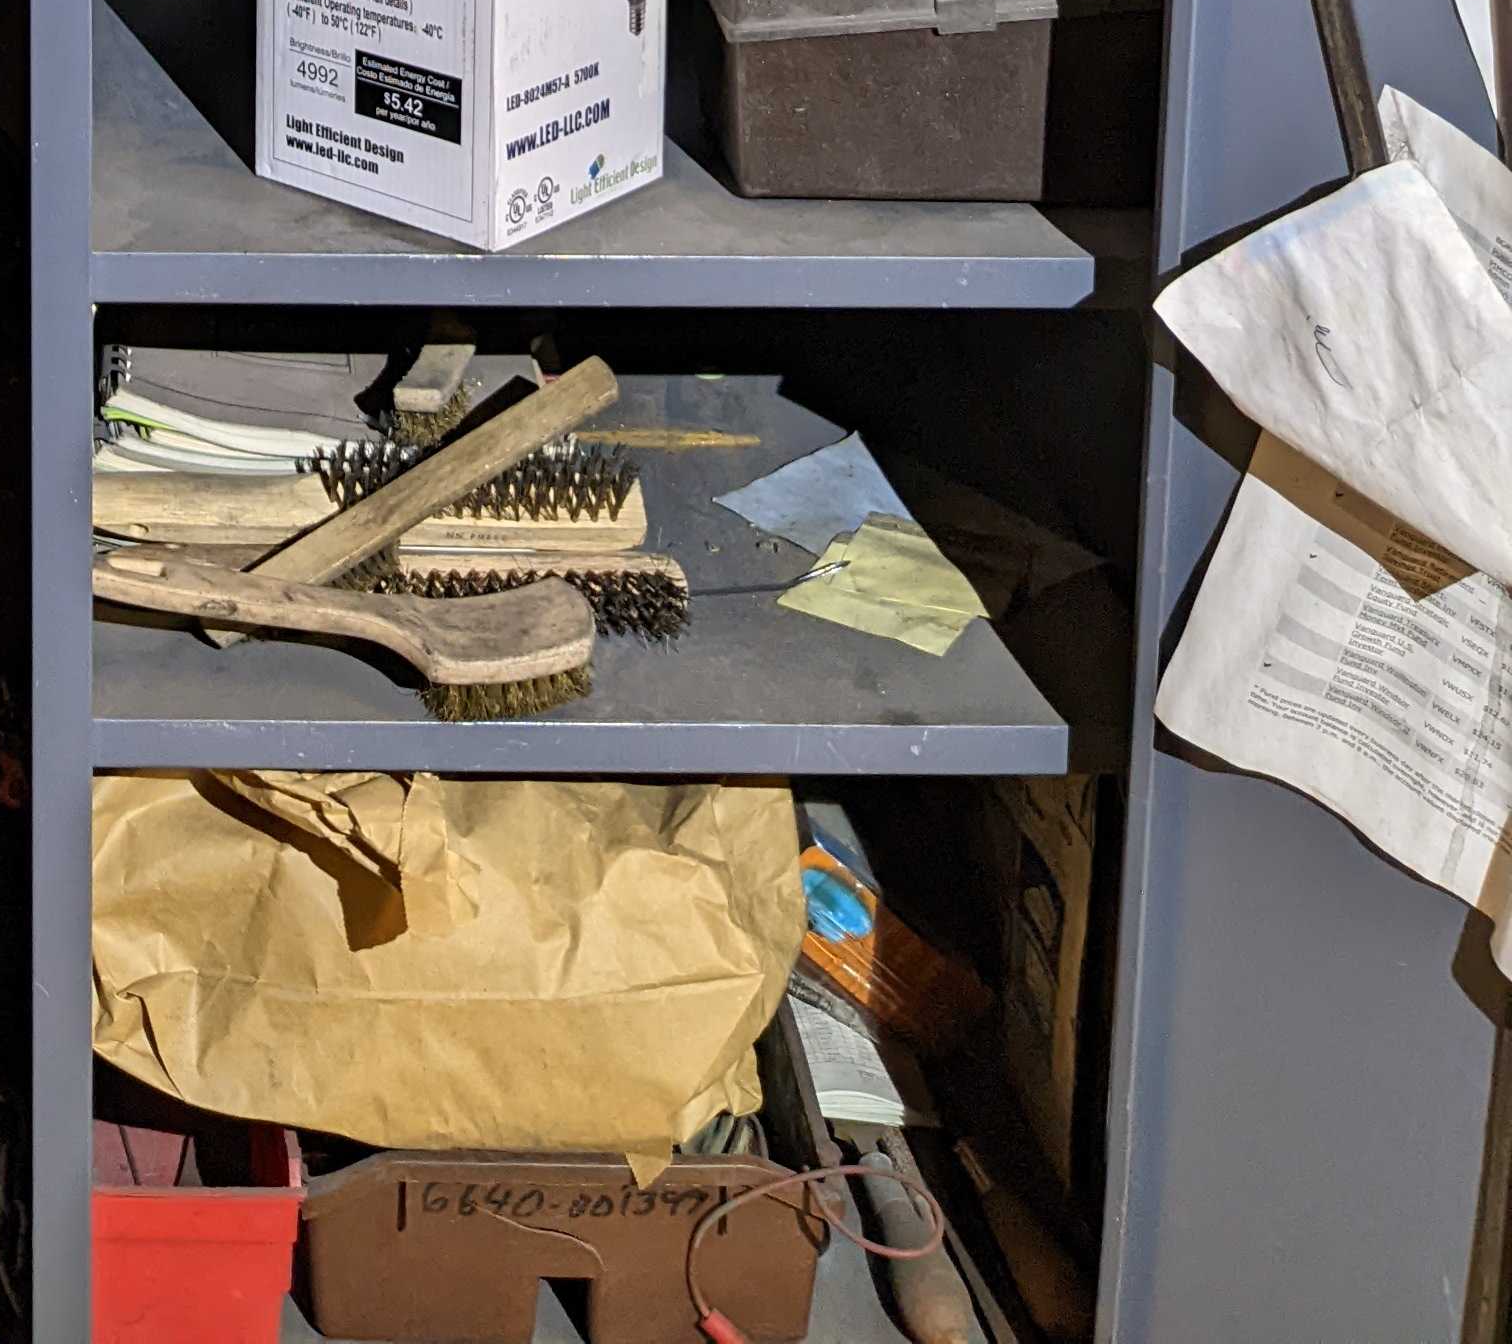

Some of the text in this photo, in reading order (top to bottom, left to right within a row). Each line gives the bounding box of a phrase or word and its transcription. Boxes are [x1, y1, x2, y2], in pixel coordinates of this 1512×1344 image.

[321, 12, 329, 25] to
[289, 37, 351, 62] Brightness/Brillo
[297, 60, 338, 87] 4992
[356, 66, 377, 80] Costo
[415, 82, 424, 92] de
[362, 57, 398, 74] Estimated
[400, 68, 426, 83] Energy
[383, 92, 423, 117] $5.42
[286, 113, 404, 164] Light Efficient Design
[506, 98, 611, 161] WWW.LED-LLC.COM
[286, 134, 379, 175] www.led-llc.com
[570, 154, 658, 205] Light Efficient Design
